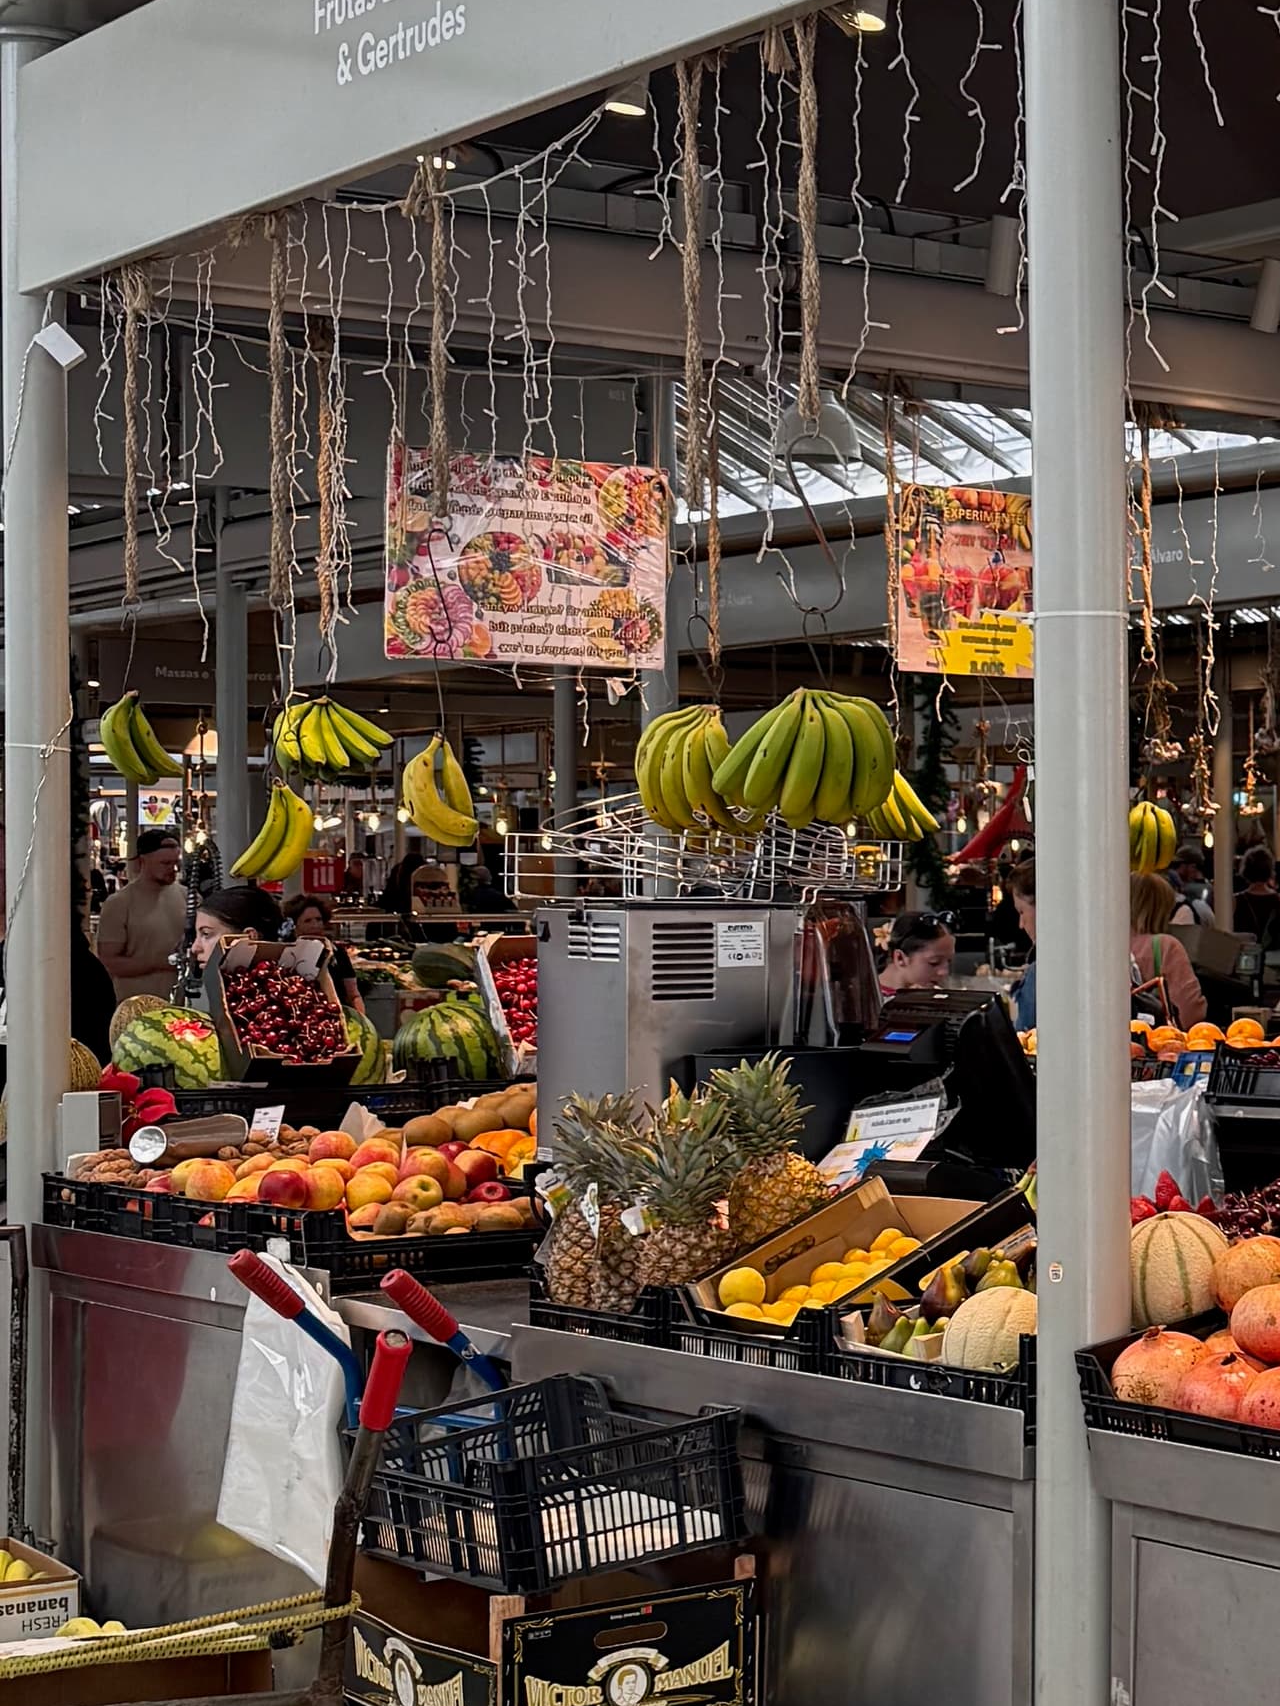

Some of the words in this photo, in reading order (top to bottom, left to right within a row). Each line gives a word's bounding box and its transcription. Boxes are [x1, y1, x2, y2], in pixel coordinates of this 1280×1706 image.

[336, 42, 352, 85] &
[357, 1, 466, 75] Gertrudes
[653, 1639, 734, 1694] MANUEL
